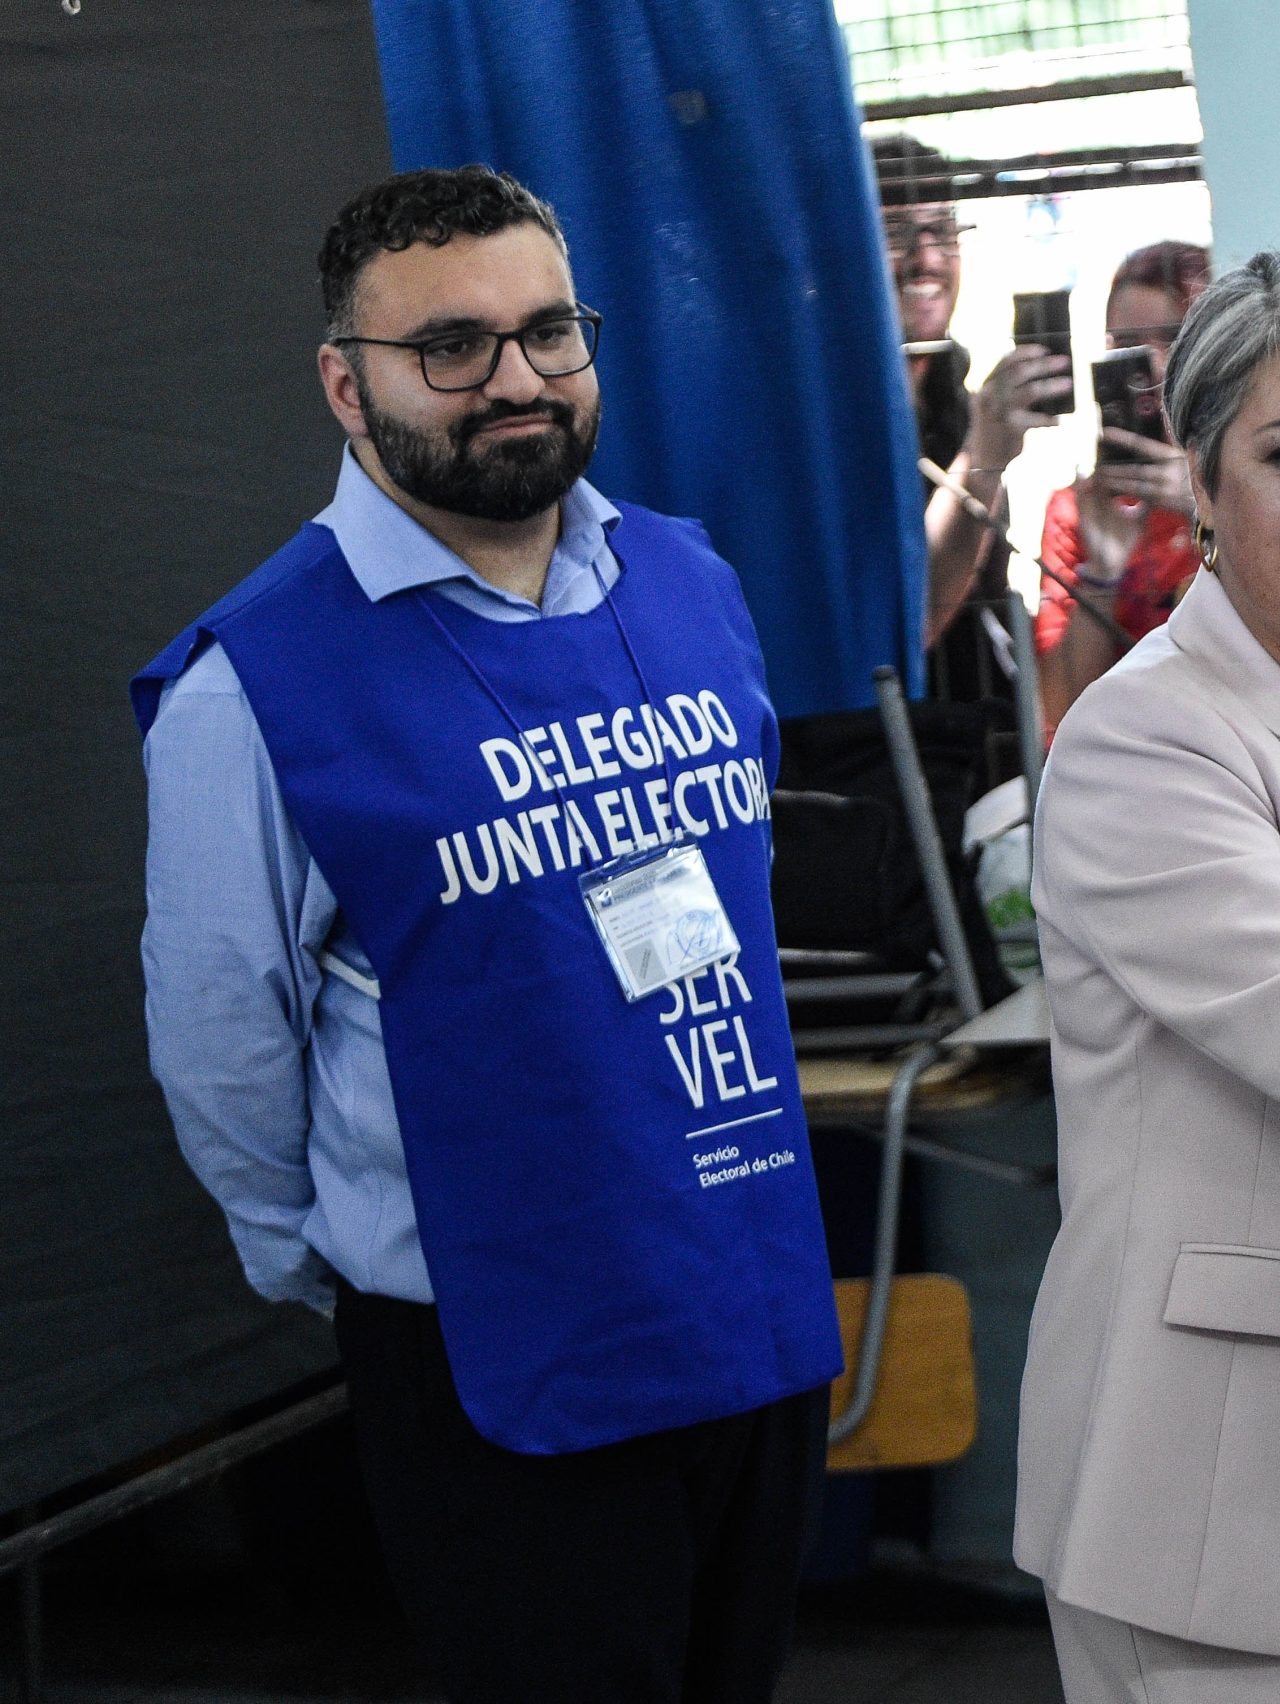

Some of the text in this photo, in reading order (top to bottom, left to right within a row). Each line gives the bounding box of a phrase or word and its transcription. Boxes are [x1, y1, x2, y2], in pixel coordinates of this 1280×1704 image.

[480, 689, 738, 802] DELEGADO
[436, 800, 602, 904] JUNTA
[665, 1015, 778, 1109] VEL
[693, 1145, 740, 1169] Servicio
[700, 1149, 796, 1188] Electoral de Chile
